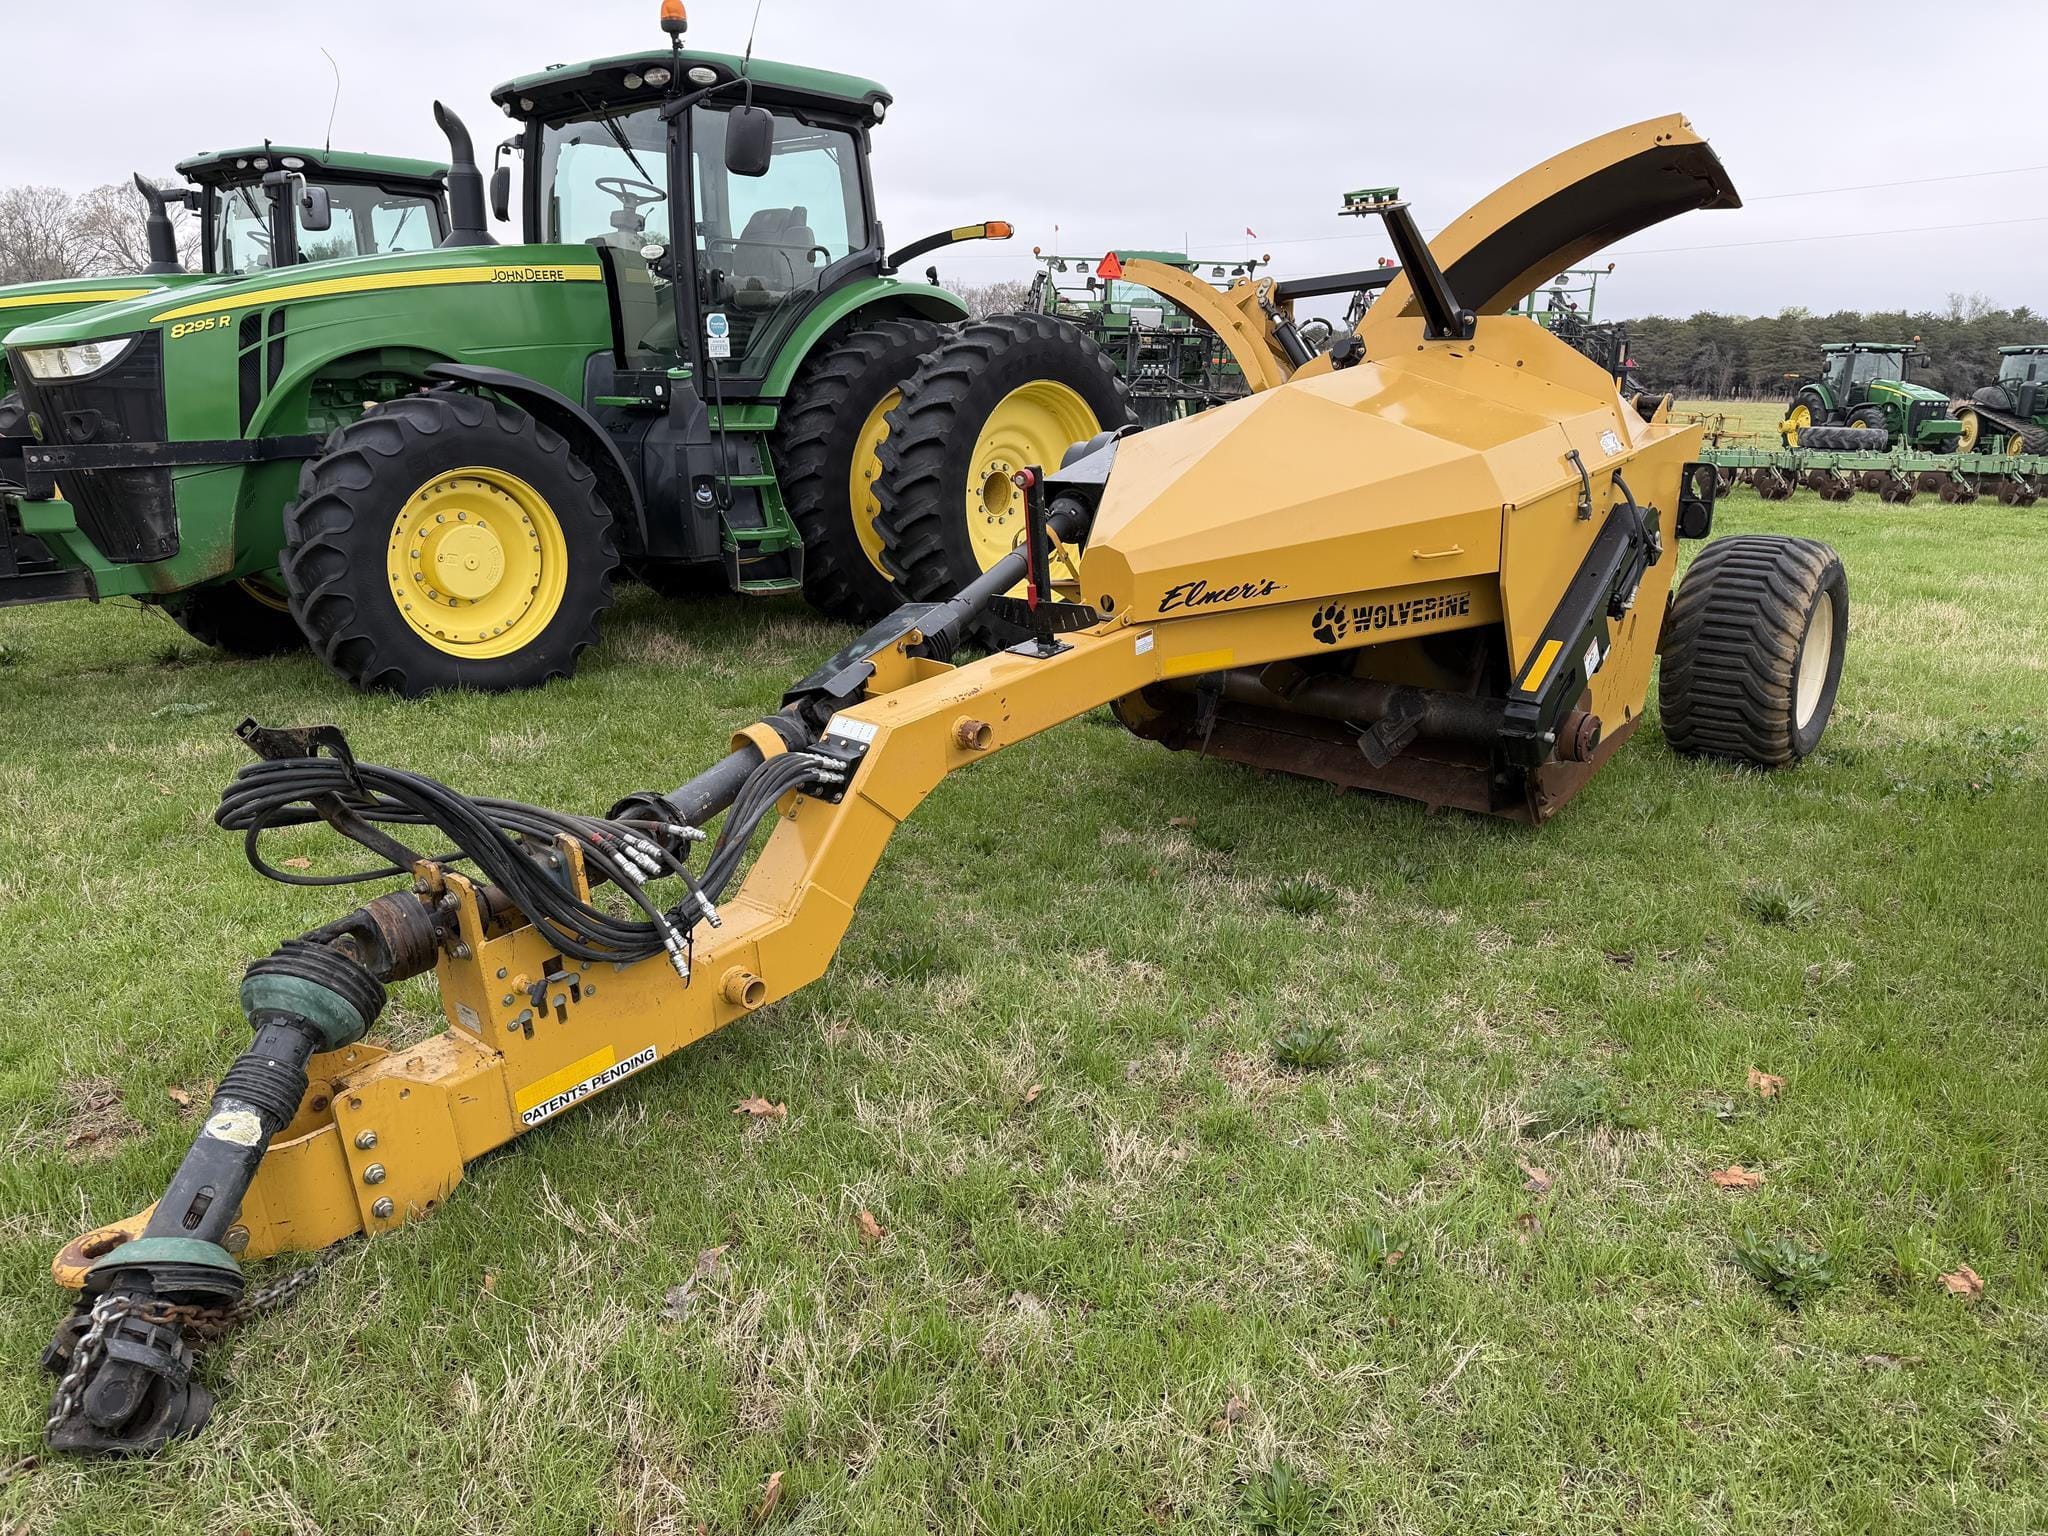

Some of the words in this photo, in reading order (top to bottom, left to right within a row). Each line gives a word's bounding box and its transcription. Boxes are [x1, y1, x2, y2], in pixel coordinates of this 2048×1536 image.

[491, 269, 524, 281] JOHN
[525, 268, 565, 280] DEERE
[170, 318, 215, 339] 8295
[219, 315, 231, 328] R
[1158, 579, 1282, 613] Elmer's
[1352, 591, 1471, 633] WOLVERINE
[523, 1083, 588, 1123] PATENTS
[592, 1049, 655, 1090] PENDING
